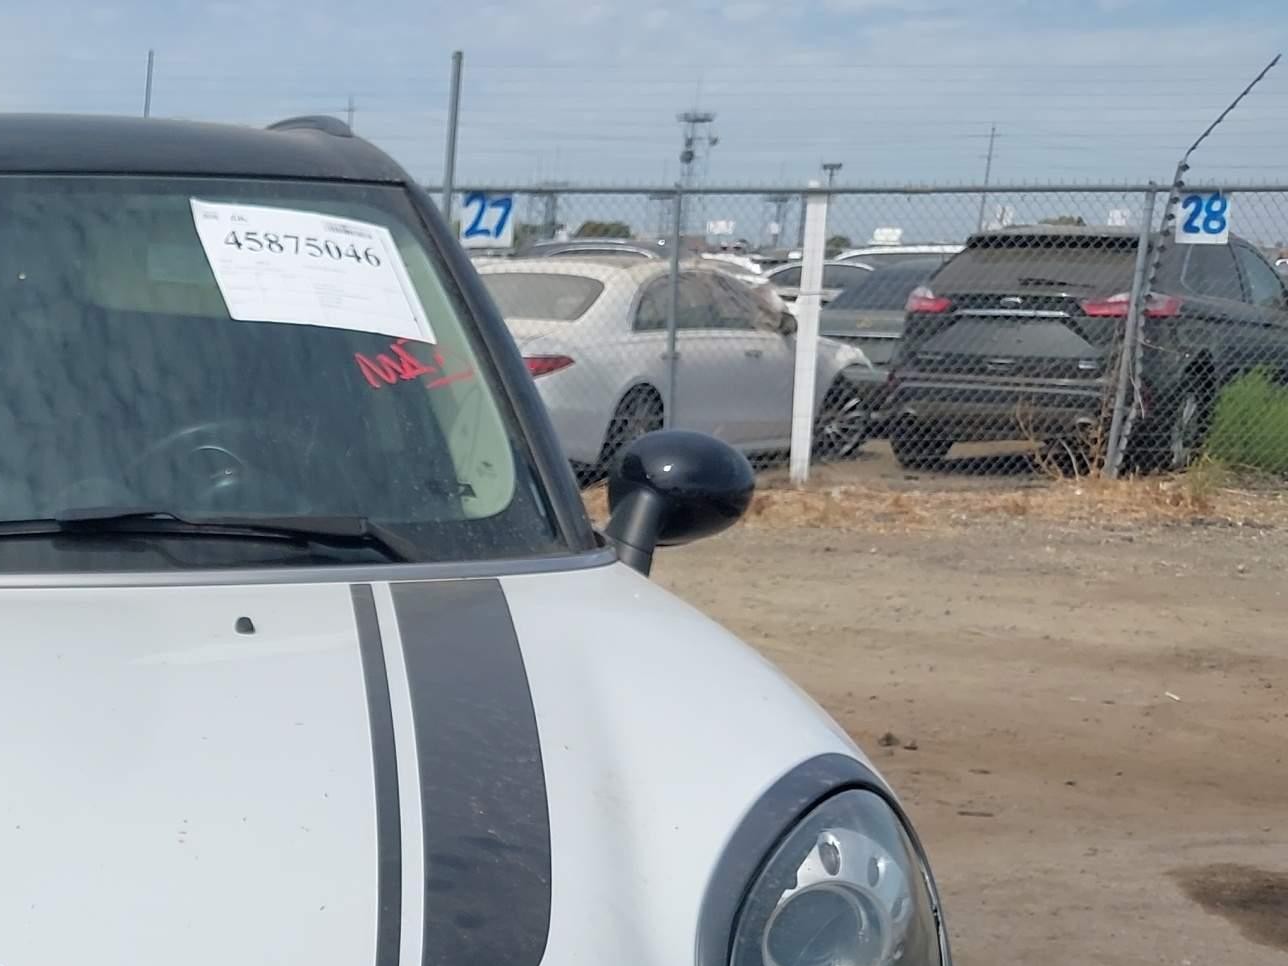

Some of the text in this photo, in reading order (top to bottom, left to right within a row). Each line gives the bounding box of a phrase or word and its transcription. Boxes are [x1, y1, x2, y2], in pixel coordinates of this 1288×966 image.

[463, 190, 512, 239] 27
[1182, 191, 1227, 234] 28
[224, 230, 381, 267] 45875046
